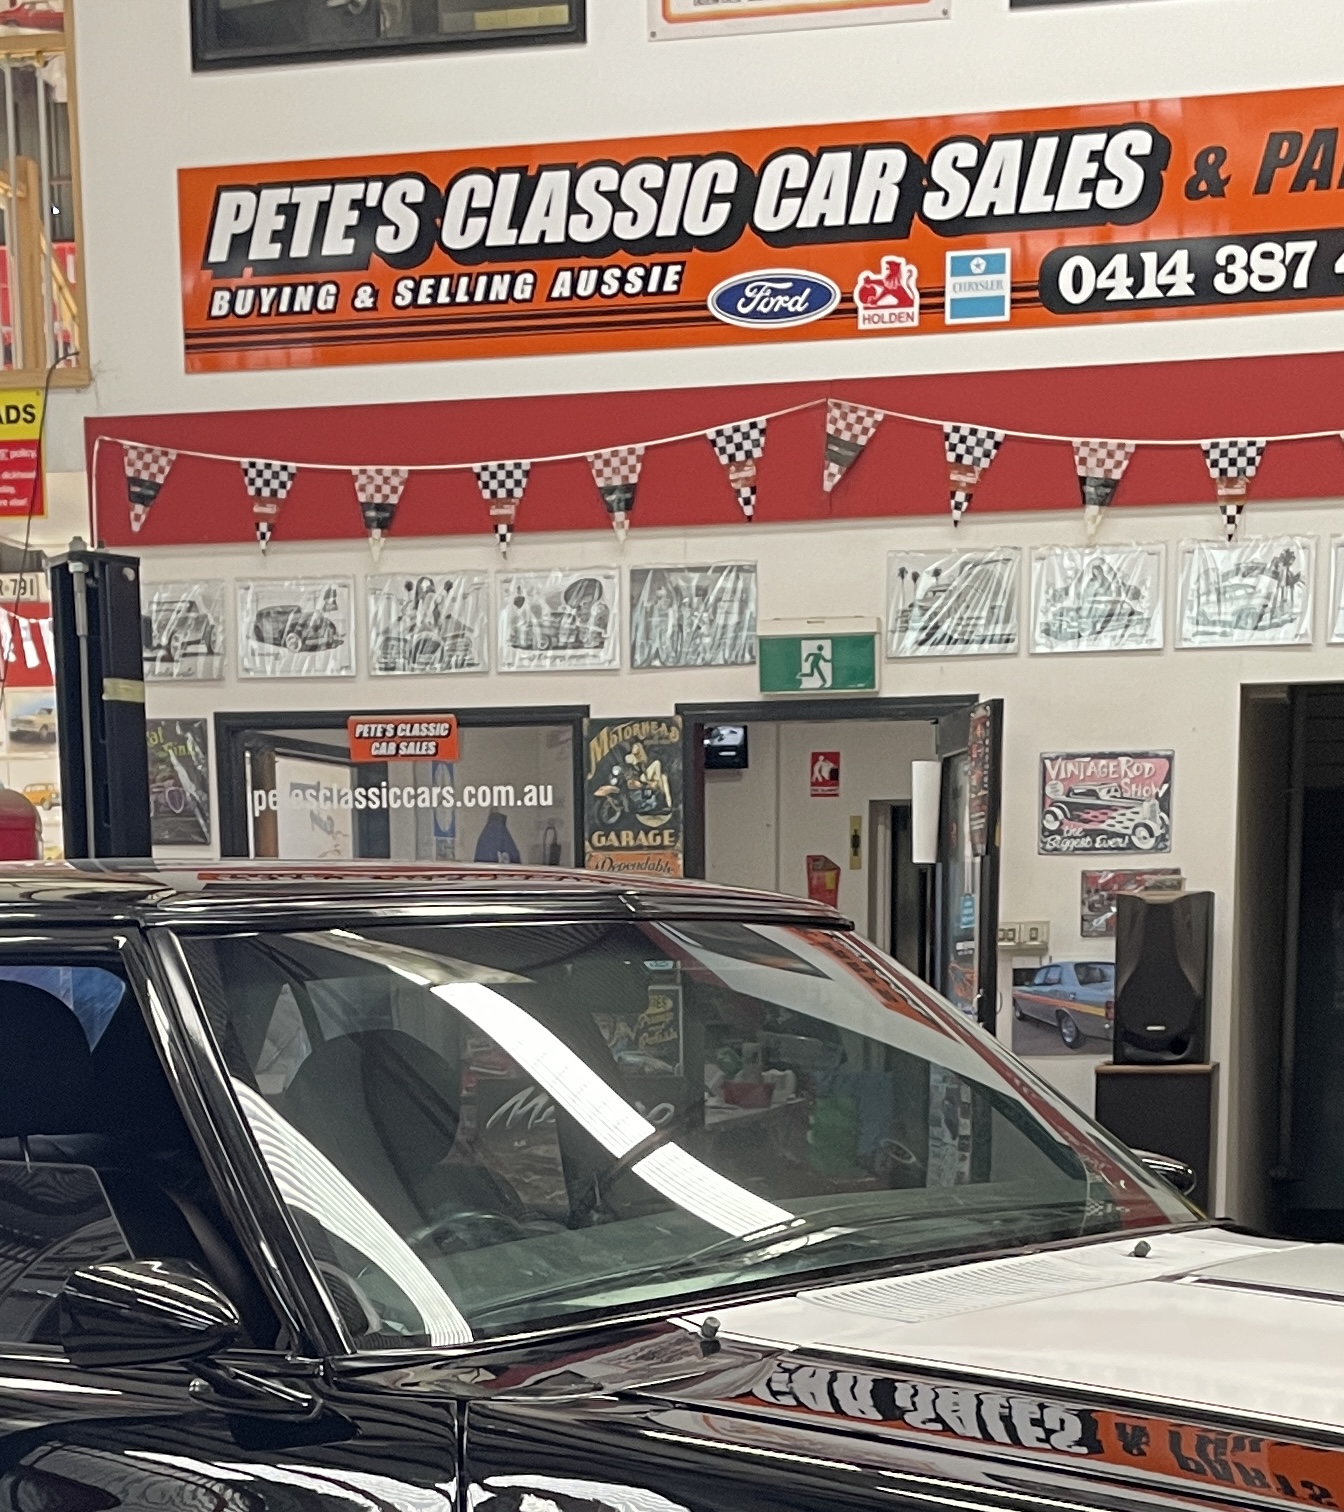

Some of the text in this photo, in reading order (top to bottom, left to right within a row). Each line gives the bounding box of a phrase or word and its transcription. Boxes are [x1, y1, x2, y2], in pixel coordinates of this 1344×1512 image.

[208, 176, 425, 263] PETE'S
[442, 158, 738, 252] CLASSIC
[754, 145, 907, 231] CAR
[921, 128, 1154, 222] SALES
[1183, 145, 1231, 200] &
[1057, 248, 1196, 304] 0414
[1213, 240, 1318, 293] 387
[210, 262, 683, 318] BUYING & SELLING AUSSIE
[952, 276, 1005, 295] CHRYSLER
[735, 283, 810, 314] Ford
[861, 310, 915, 327] HOLDEN
[355, 722, 449, 738] PETE'S CLASSIC
[371, 741, 437, 756] CAR SALES
[1043, 757, 1119, 781] VINTAGE
[253, 781, 553, 817] peesclassiccars.com.au
[591, 829, 676, 848] GARAGE
